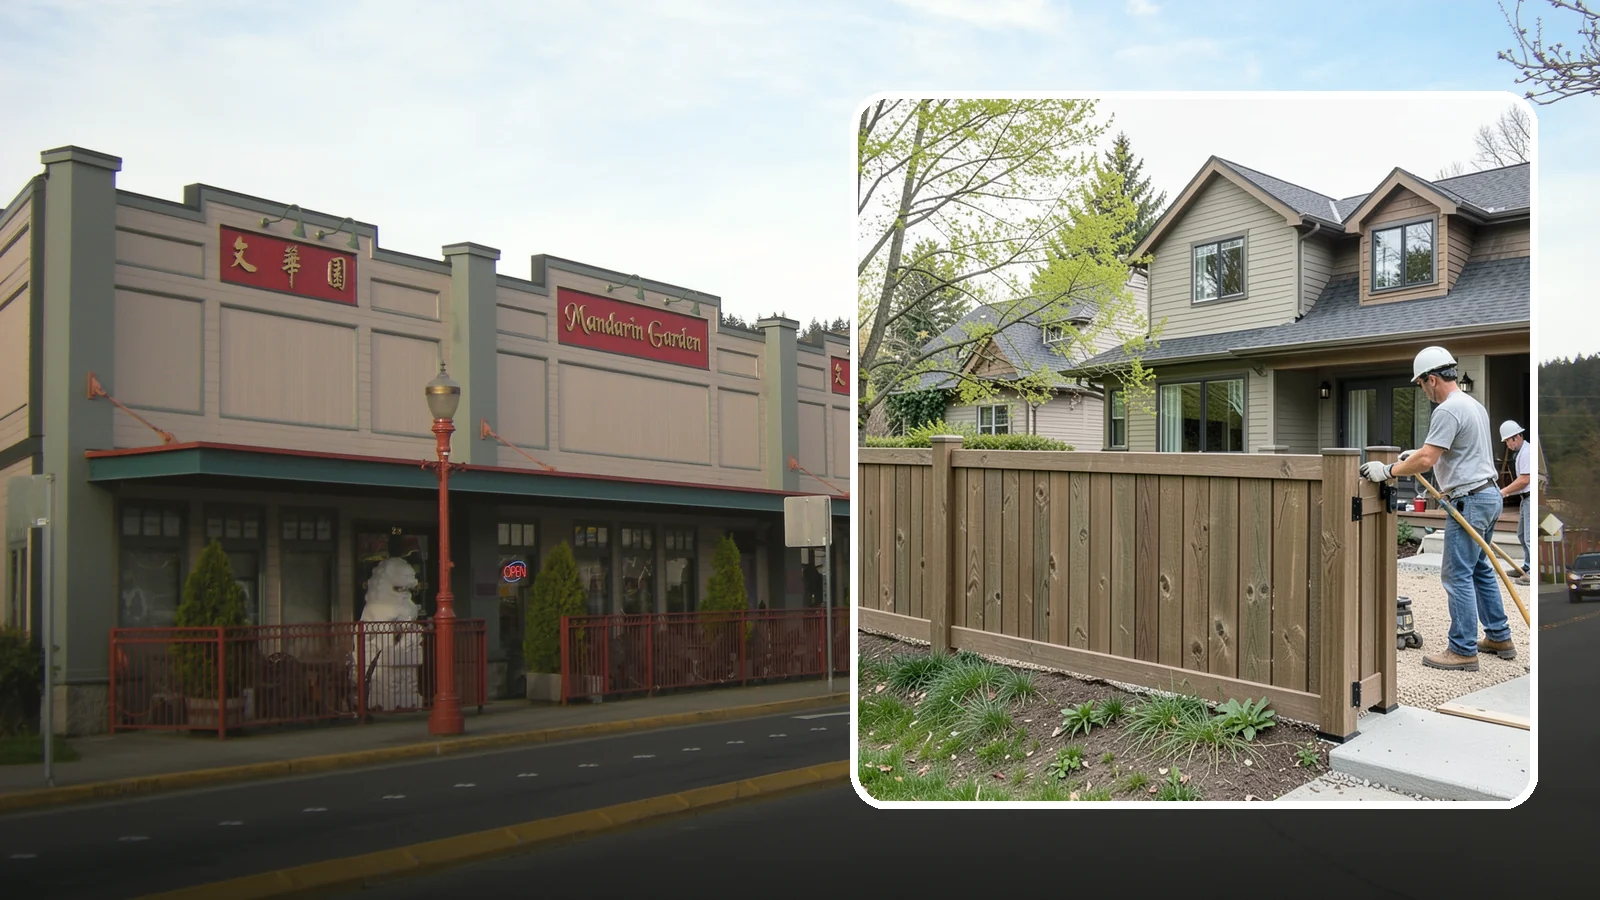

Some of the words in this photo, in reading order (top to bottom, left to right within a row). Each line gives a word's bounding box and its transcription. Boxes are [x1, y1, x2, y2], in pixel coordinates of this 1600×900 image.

[231, 235, 347, 291] 文華園
[565, 302, 644, 341] Mandarin
[648, 320, 702, 352] Garden
[503, 565, 526, 578] OPEN
